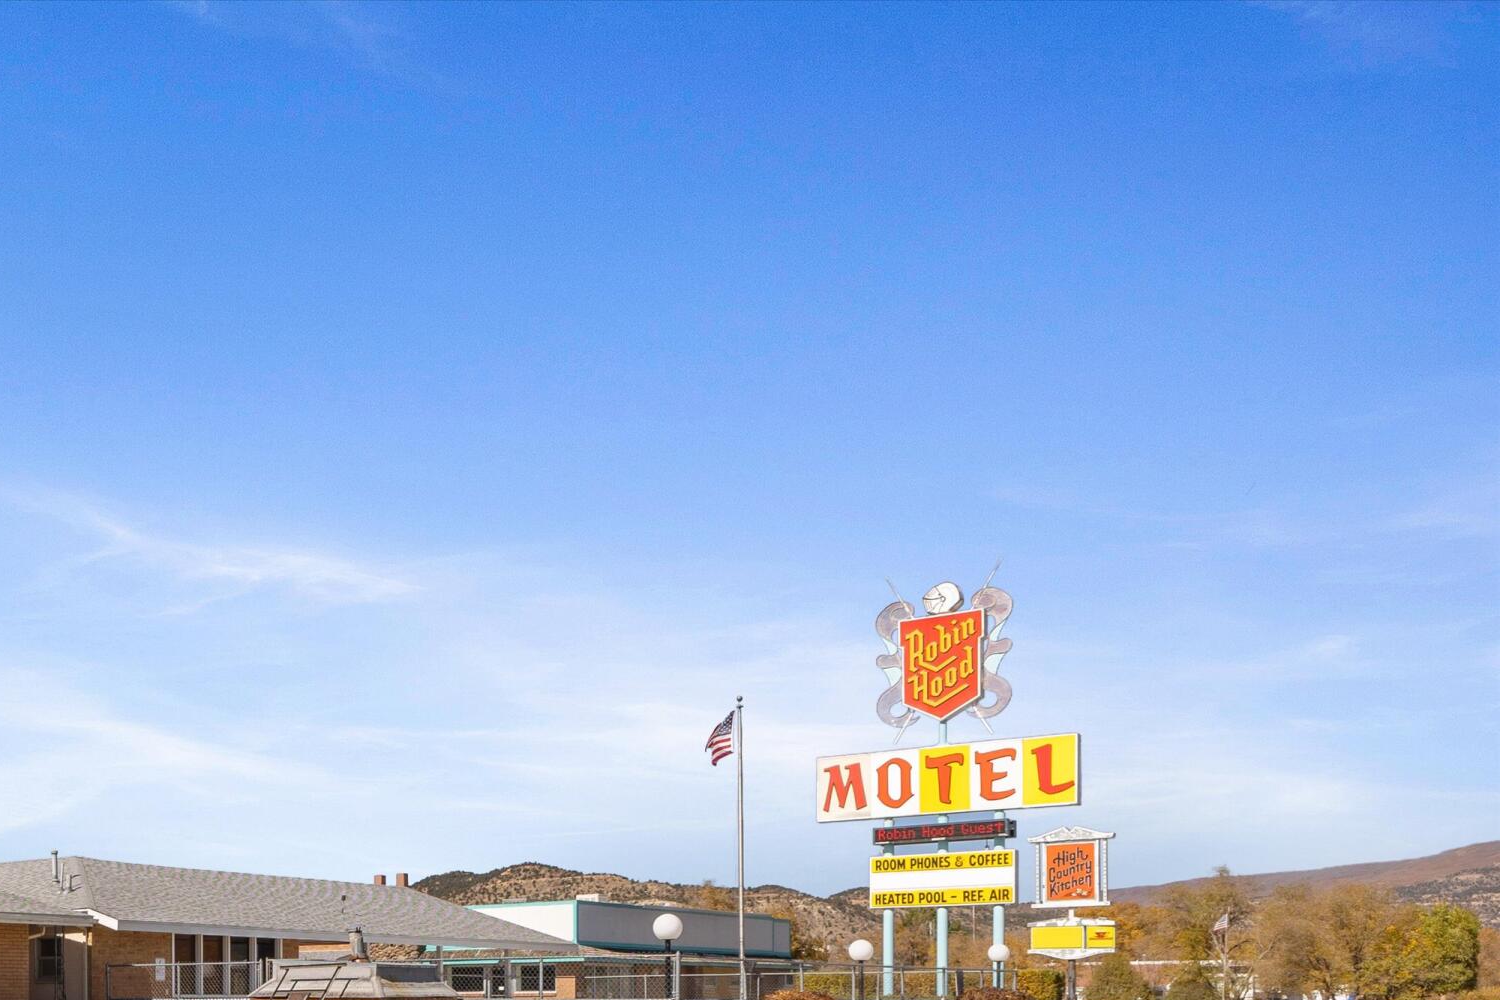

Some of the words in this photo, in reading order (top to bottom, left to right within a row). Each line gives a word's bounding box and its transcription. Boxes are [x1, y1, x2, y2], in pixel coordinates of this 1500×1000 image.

[905, 617, 976, 673] Robin
[907, 645, 975, 708] Hood
[823, 743, 1075, 813] MOTEL
[877, 828, 916, 840] Robin
[921, 823, 955, 838] Hood
[961, 820, 1005, 835] Guest
[875, 859, 906, 871] ROOM
[910, 856, 951, 869] PHONES
[955, 855, 964, 867] &
[969, 853, 1009, 866] COFFEE
[1053, 846, 1088, 867] High
[1048, 860, 1092, 883] Country
[875, 893, 914, 905] HEATED
[918, 892, 947, 904] POOL
[963, 890, 986, 902] REF.
[989, 889, 1010, 901] AIR
[1050, 874, 1092, 897] Kitchen
